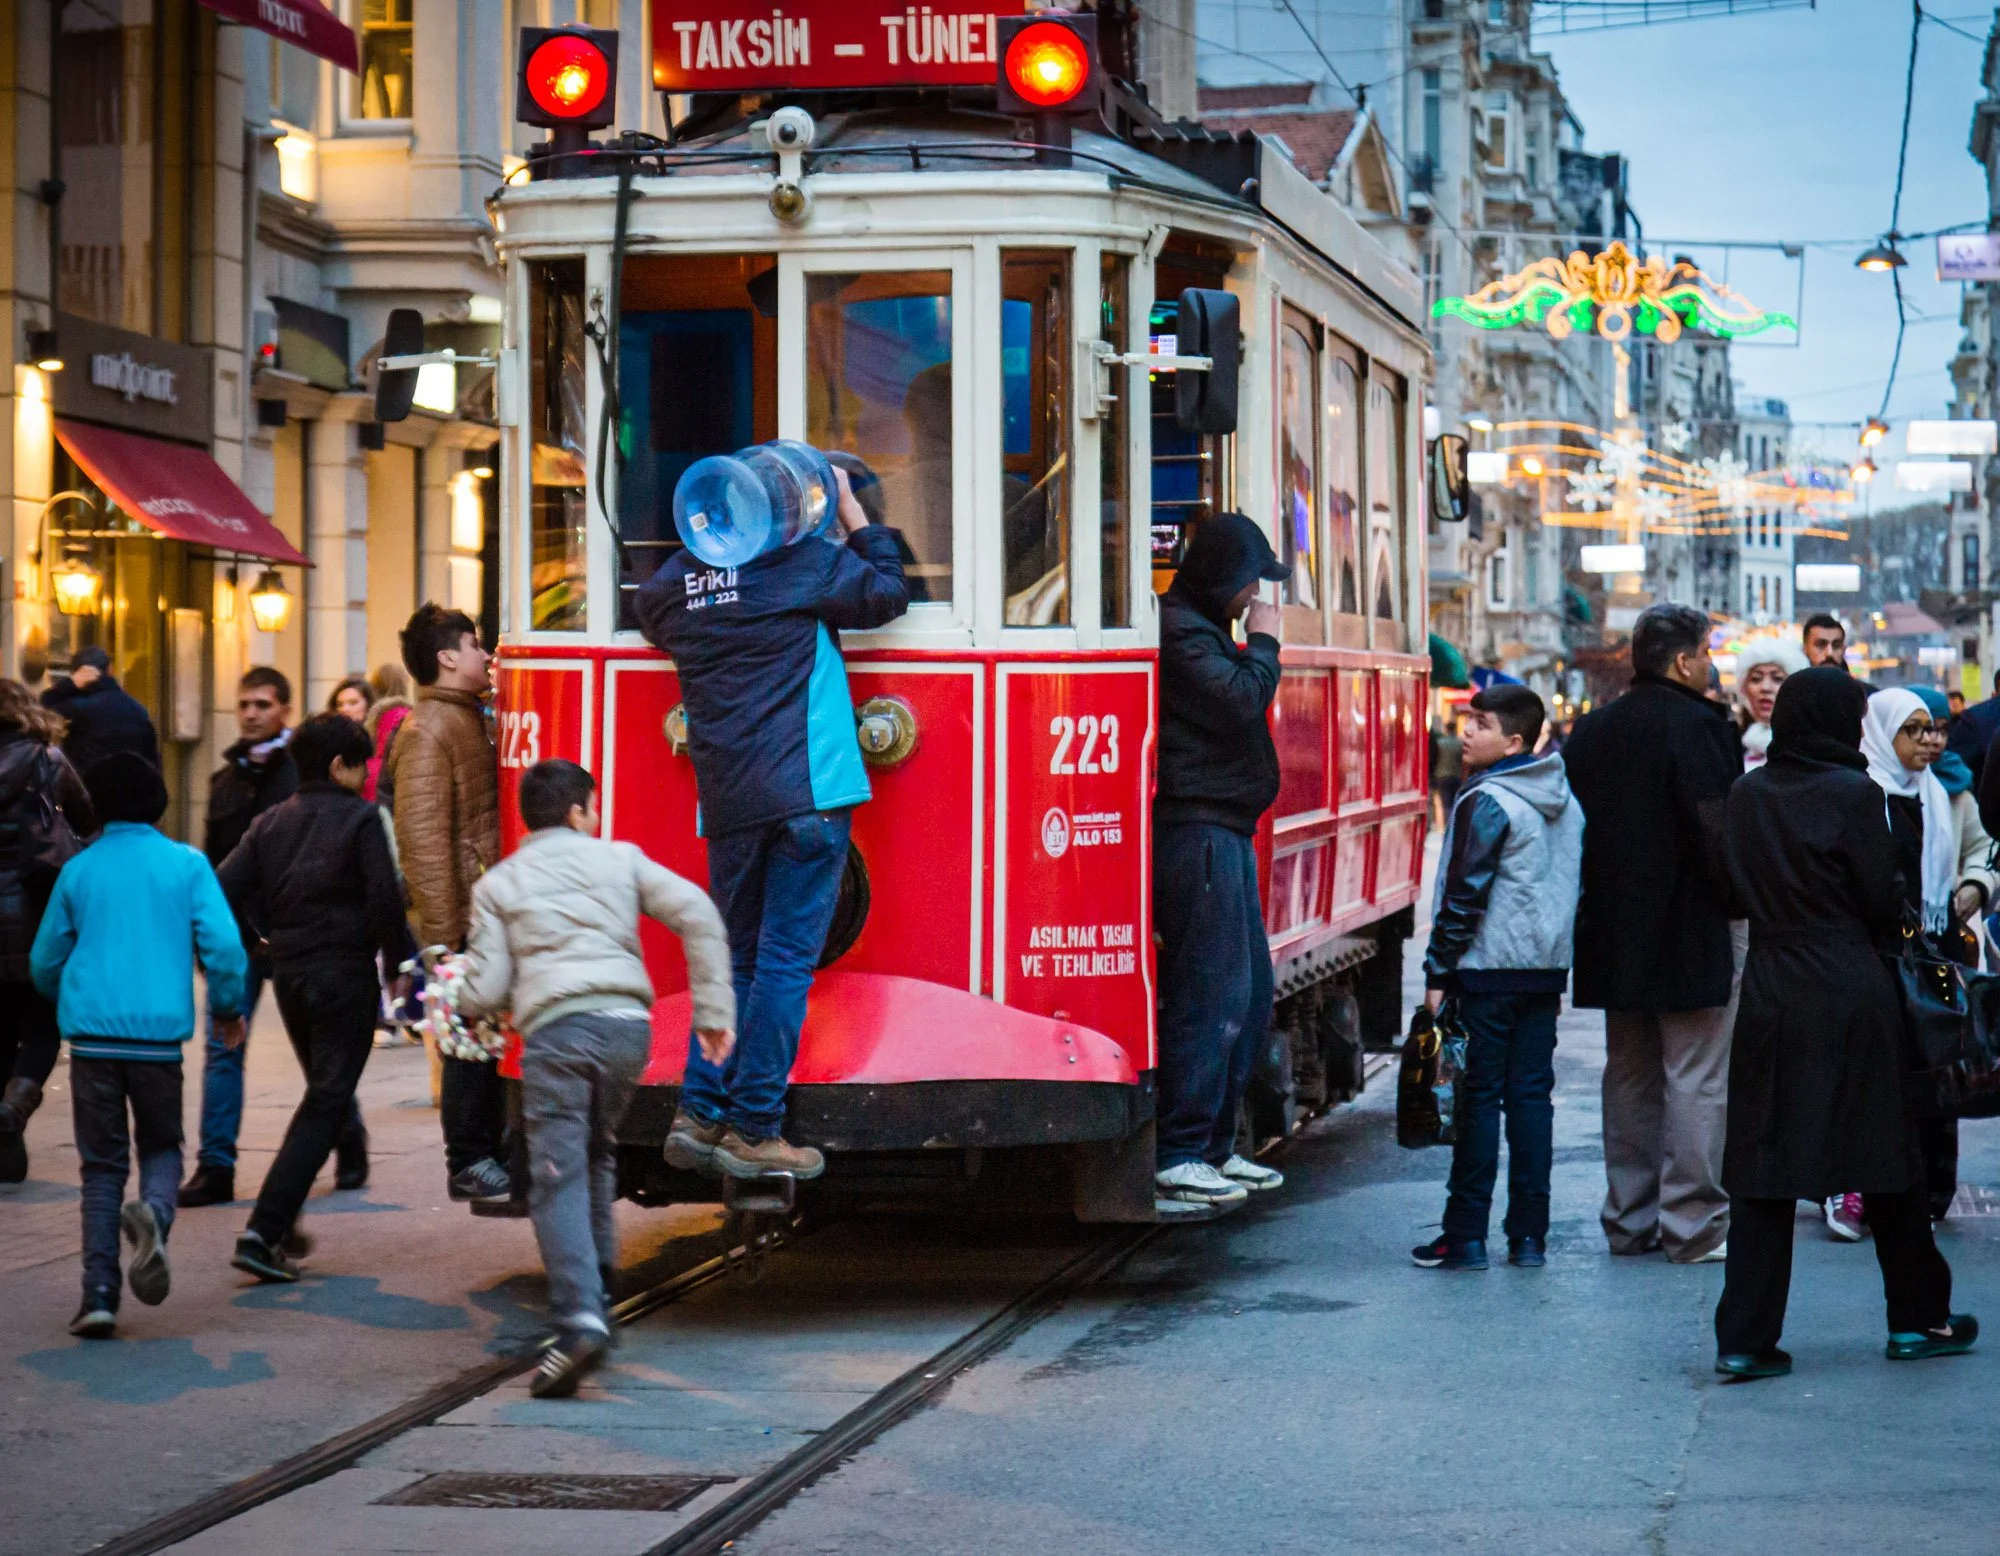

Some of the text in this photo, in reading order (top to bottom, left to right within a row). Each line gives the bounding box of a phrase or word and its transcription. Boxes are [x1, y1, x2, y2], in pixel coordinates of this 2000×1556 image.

[672, 9, 809, 69] TAKSİM
[1050, 714, 1119, 774] 223
[1072, 829, 1122, 846] ALO 153
[1029, 924, 1133, 948] ASILMAK YASAK
[1021, 955, 1044, 977] VE
